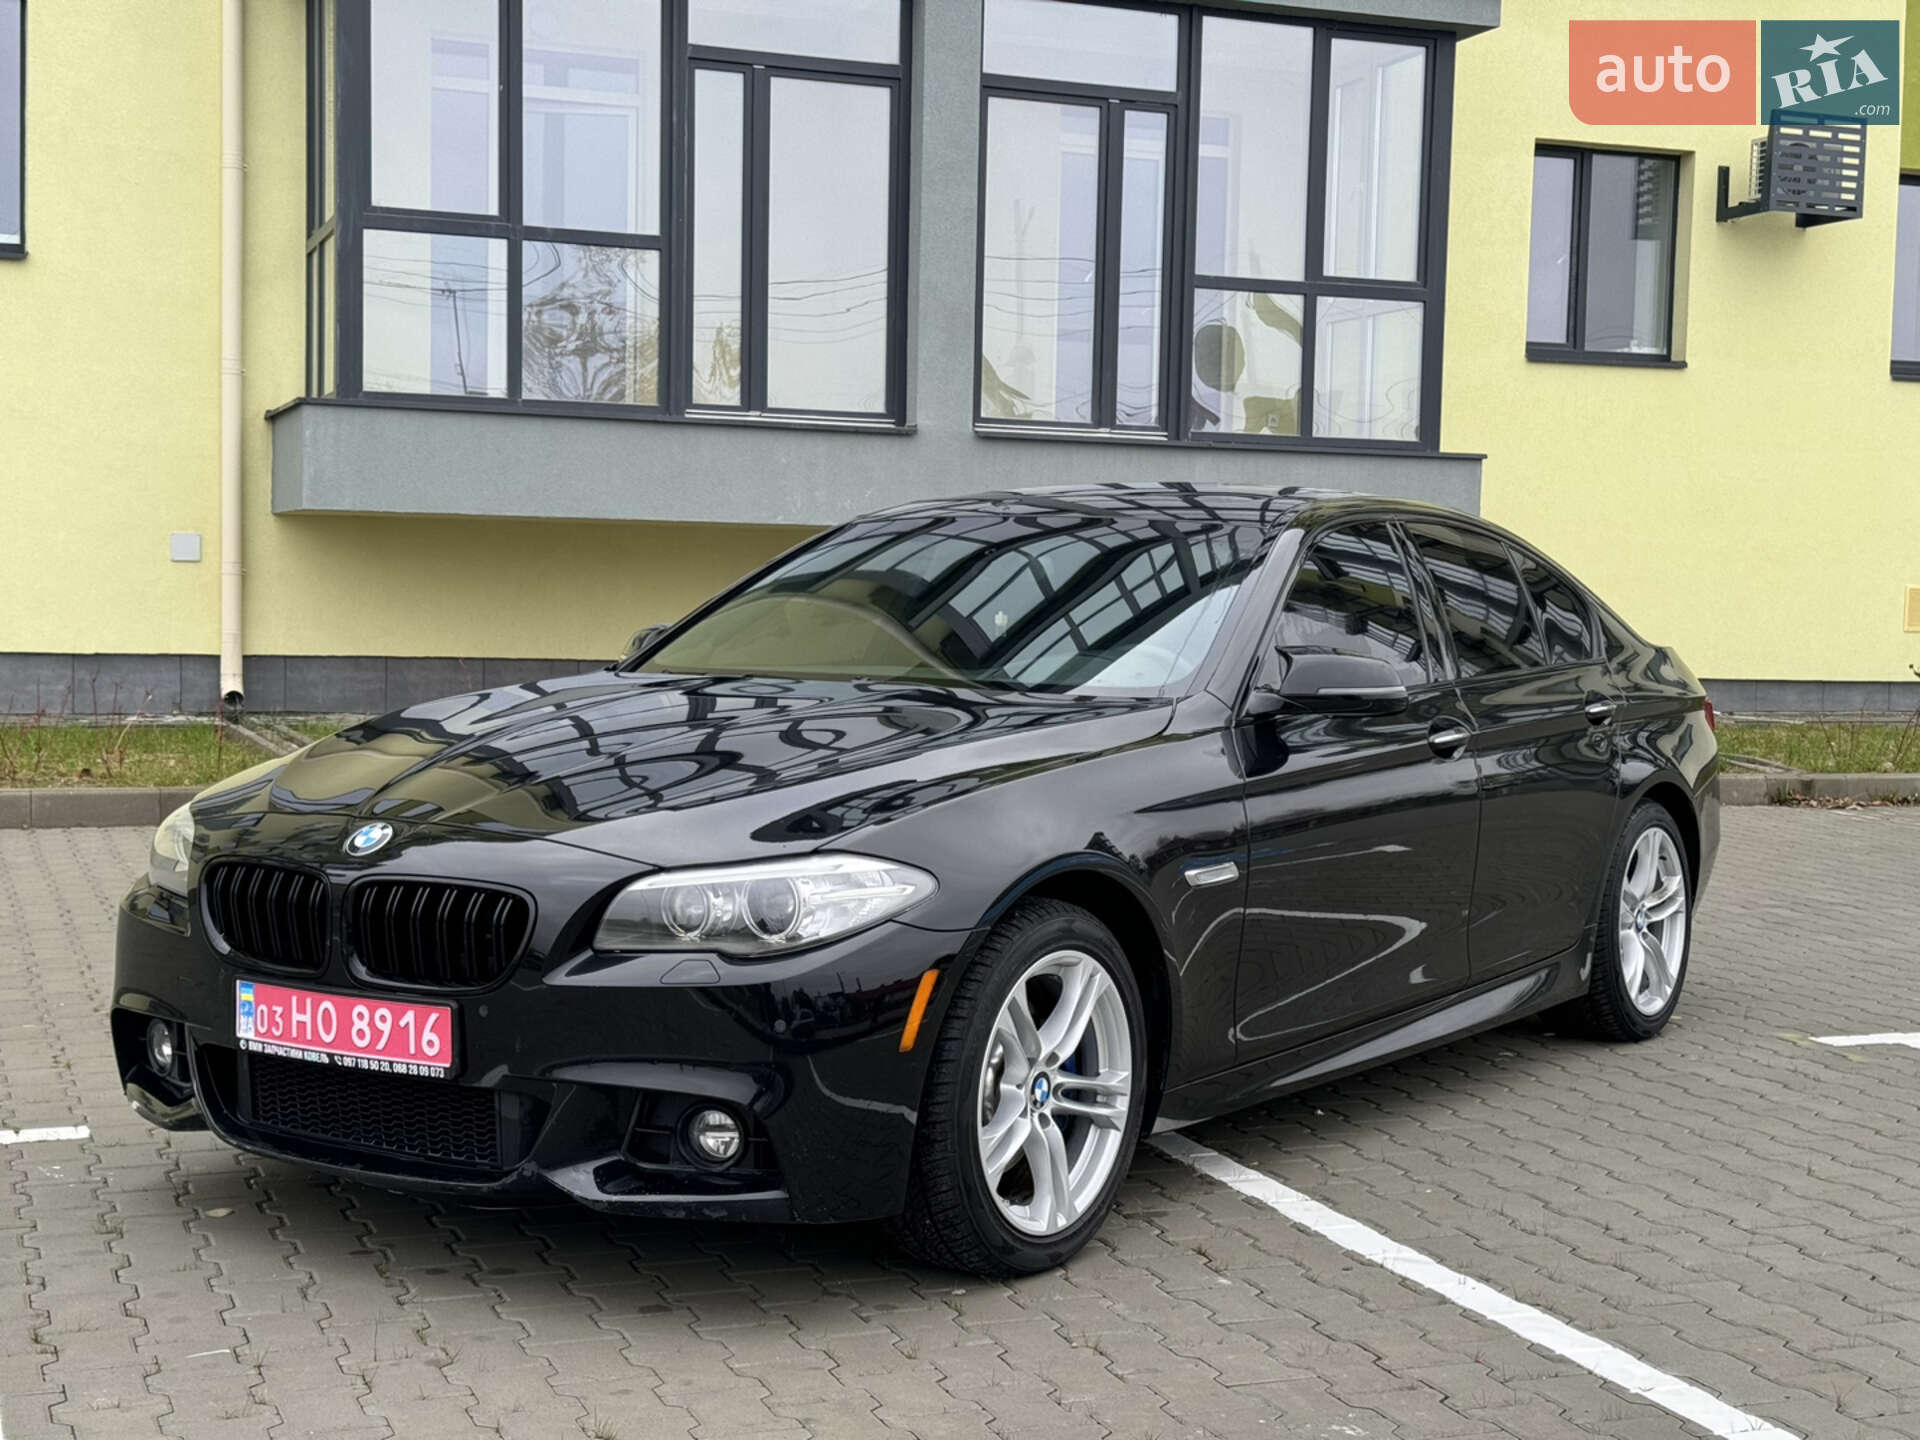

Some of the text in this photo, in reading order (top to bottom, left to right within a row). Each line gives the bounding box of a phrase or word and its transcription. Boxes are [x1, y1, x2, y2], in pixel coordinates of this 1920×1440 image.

[256, 1004, 284, 1037] 03
[351, 1004, 441, 1056] 8916
[342, 1056, 356, 1067] 097
[369, 1060, 380, 1071] 50
[408, 1063, 418, 1075] 28
[430, 1067, 445, 1078] 073
